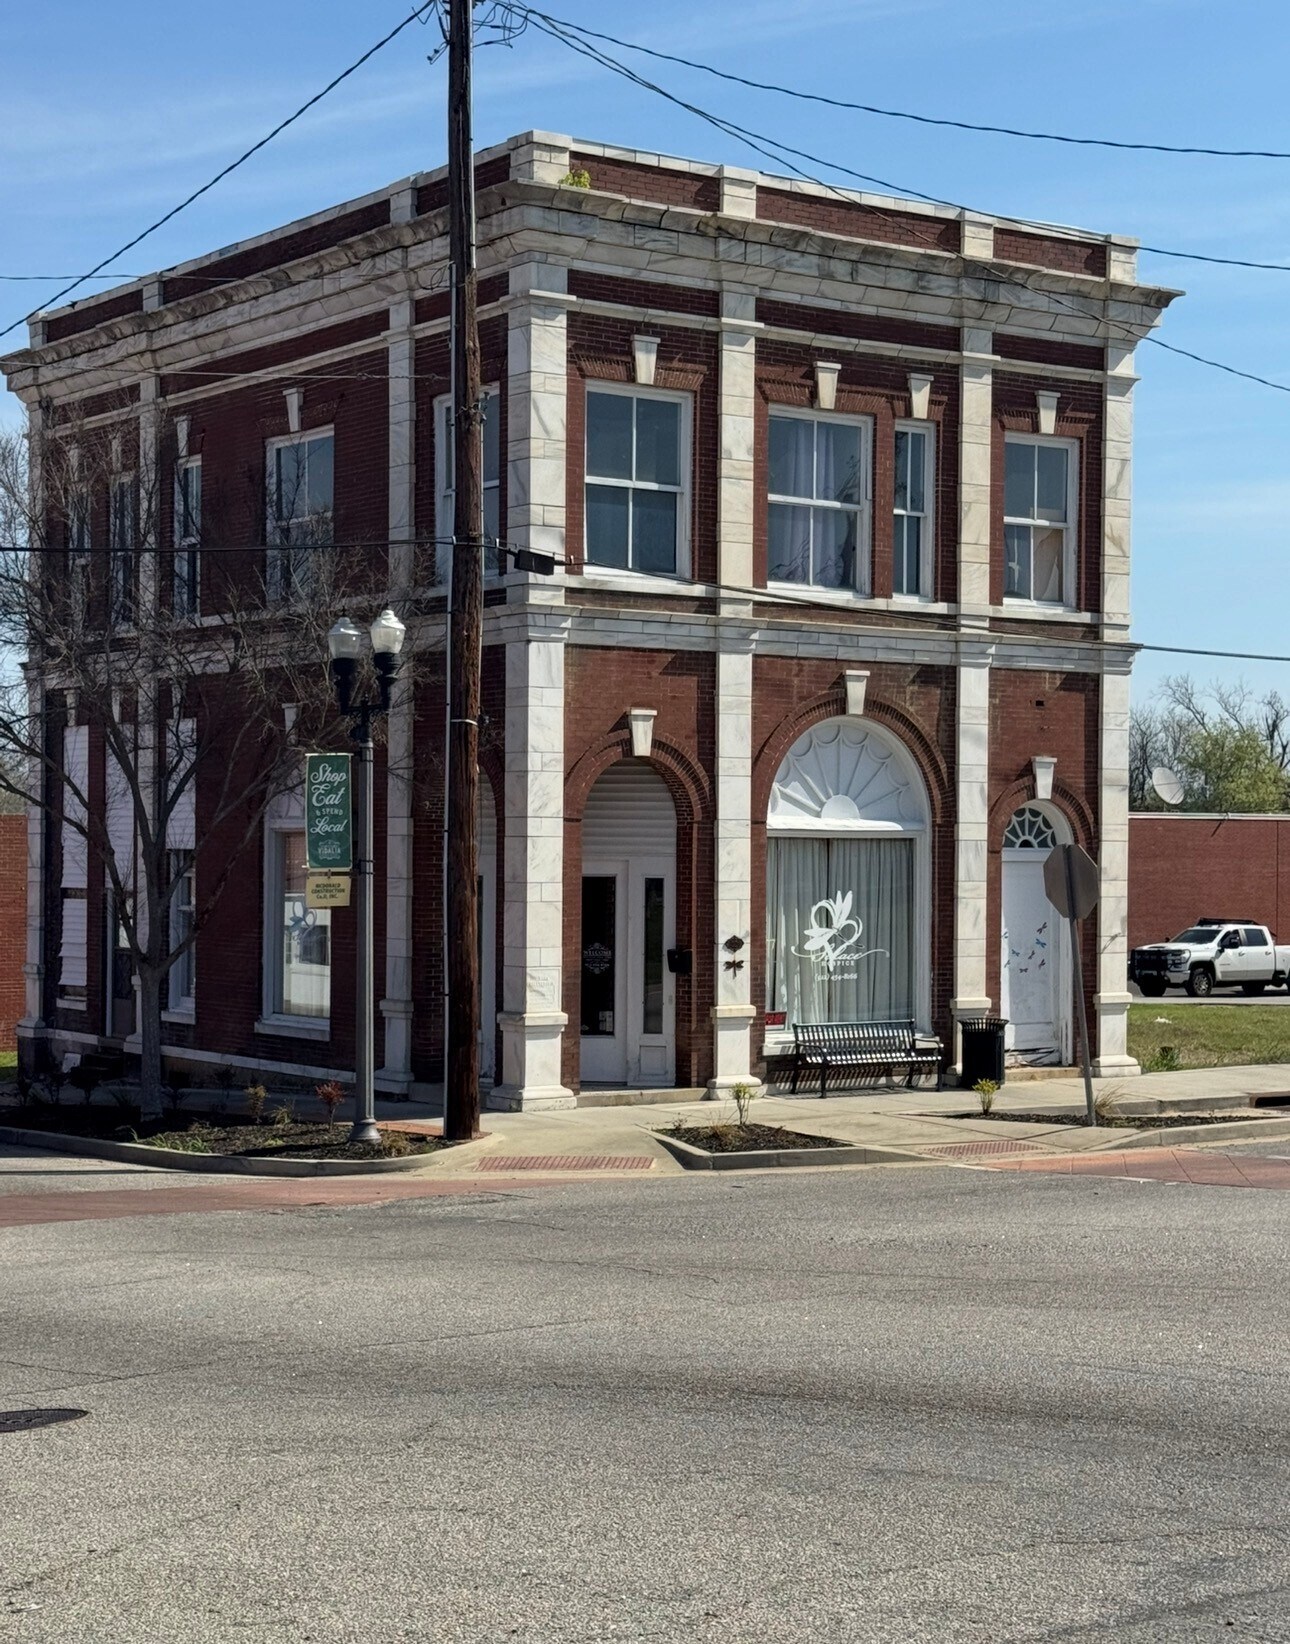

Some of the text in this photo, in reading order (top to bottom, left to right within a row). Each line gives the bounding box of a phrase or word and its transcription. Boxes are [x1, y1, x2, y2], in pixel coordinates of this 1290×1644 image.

[310, 763, 347, 786] Shop
[311, 783, 345, 807] Eat
[322, 807, 344, 816] SPEND
[310, 816, 348, 836] Local
